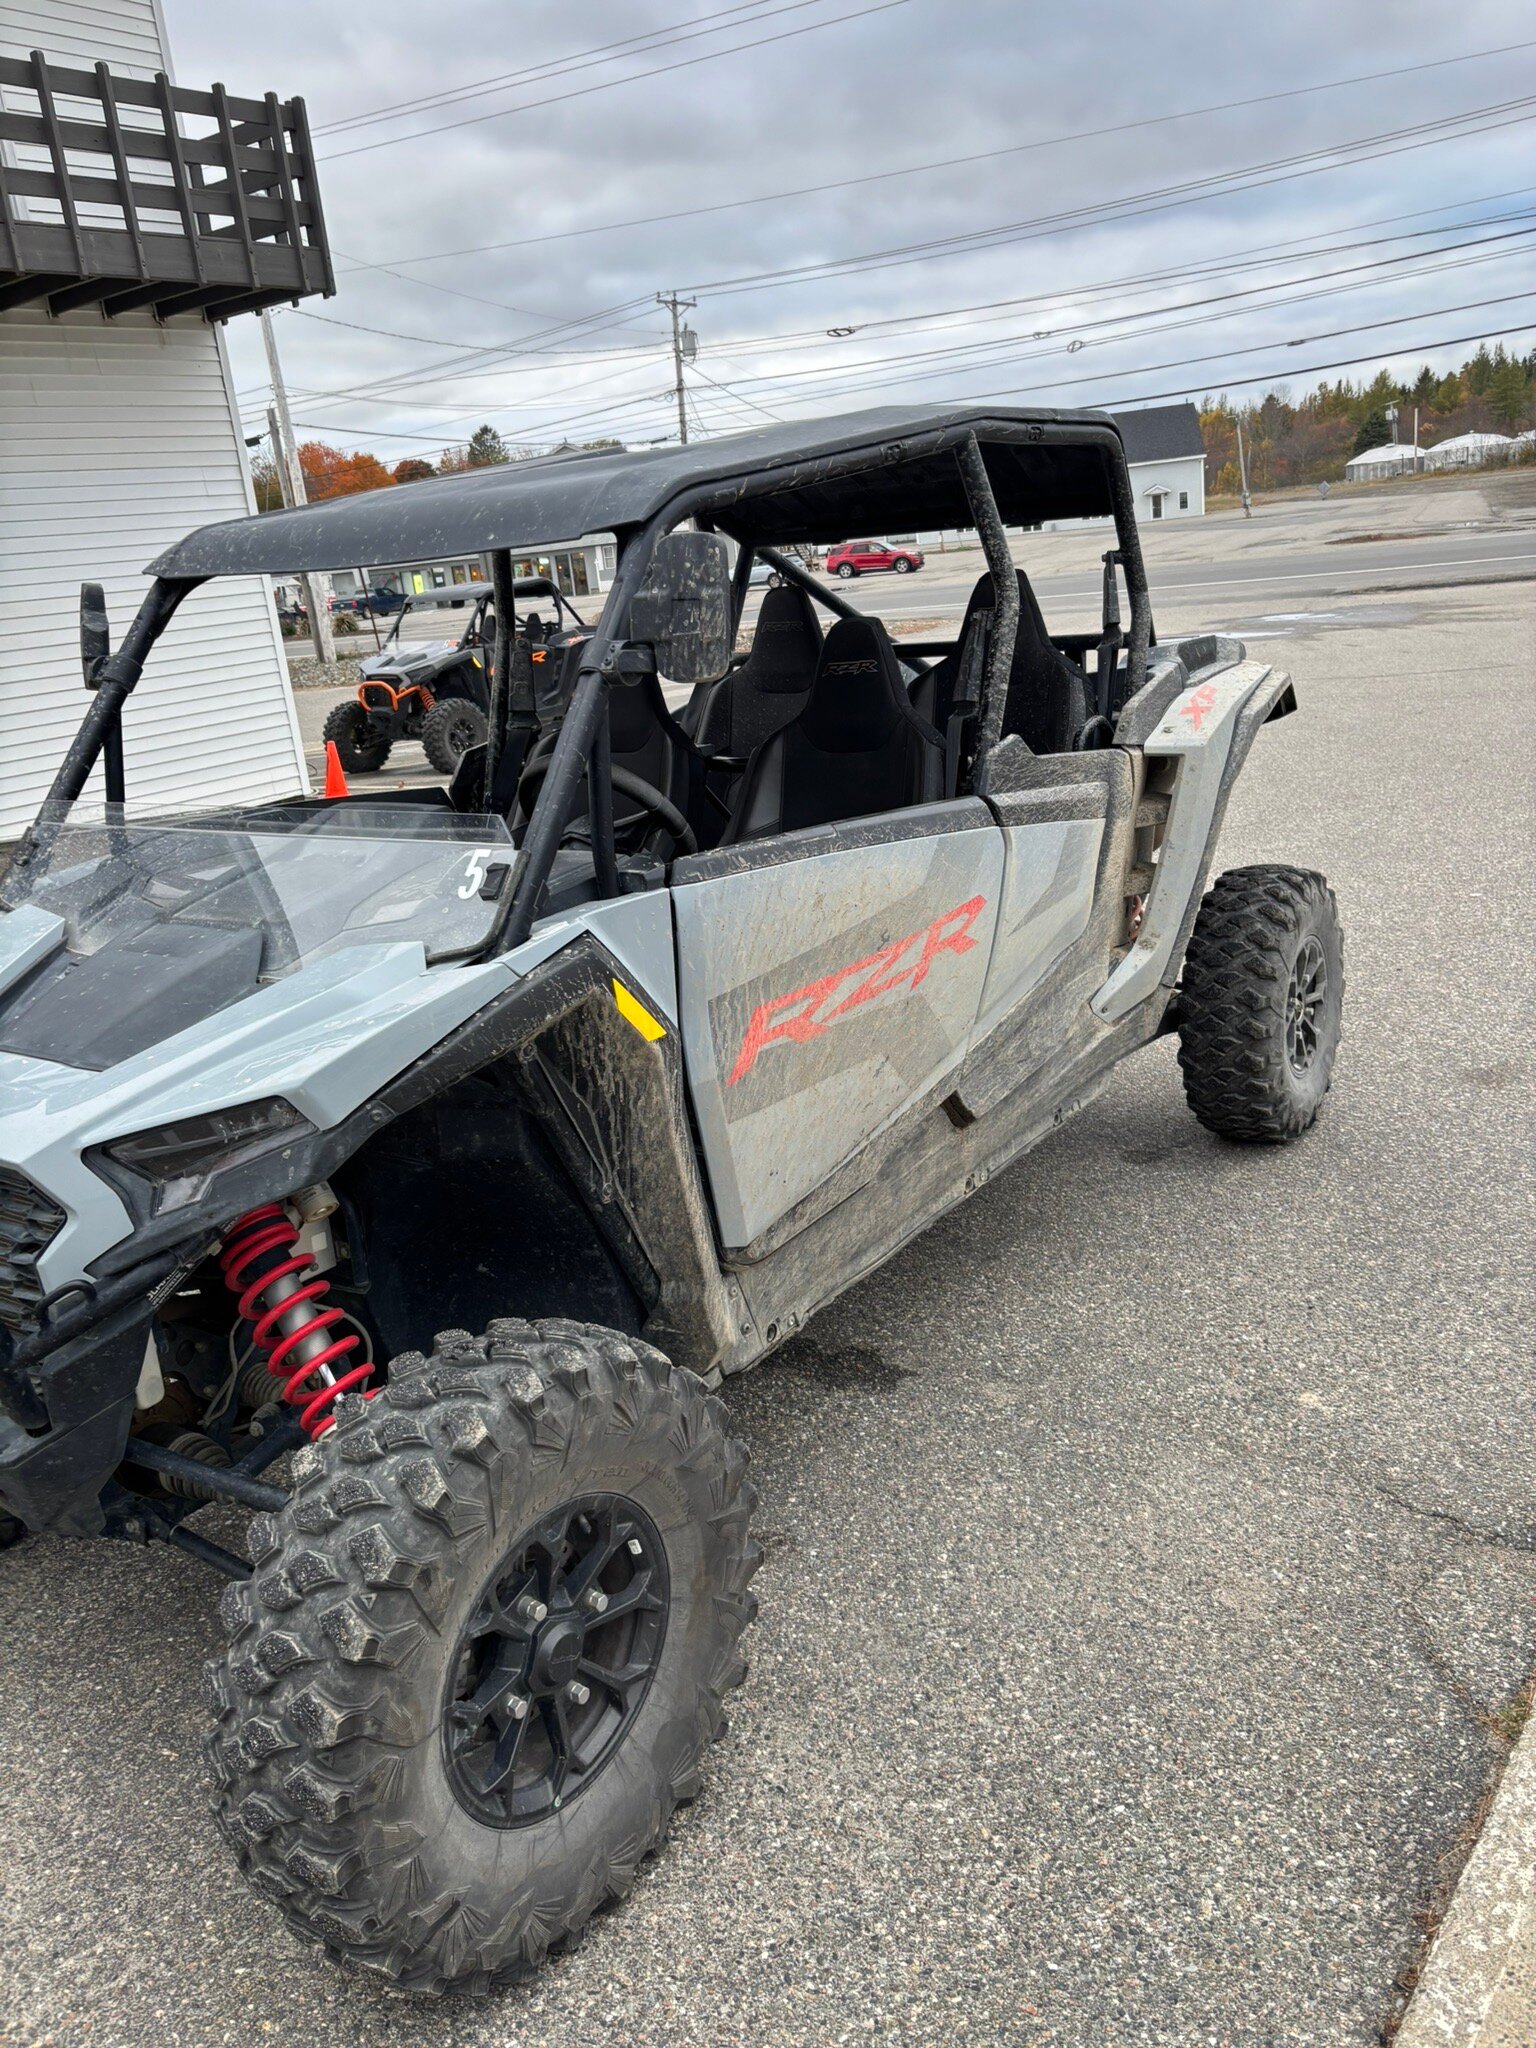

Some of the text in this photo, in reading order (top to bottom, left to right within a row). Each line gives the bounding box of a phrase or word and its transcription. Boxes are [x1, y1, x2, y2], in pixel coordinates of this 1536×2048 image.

[761, 621, 805, 632] RZR
[822, 660, 878, 677] RZR
[1179, 684, 1218, 732] XP
[458, 849, 491, 899] 5
[726, 894, 987, 1087] RZR
